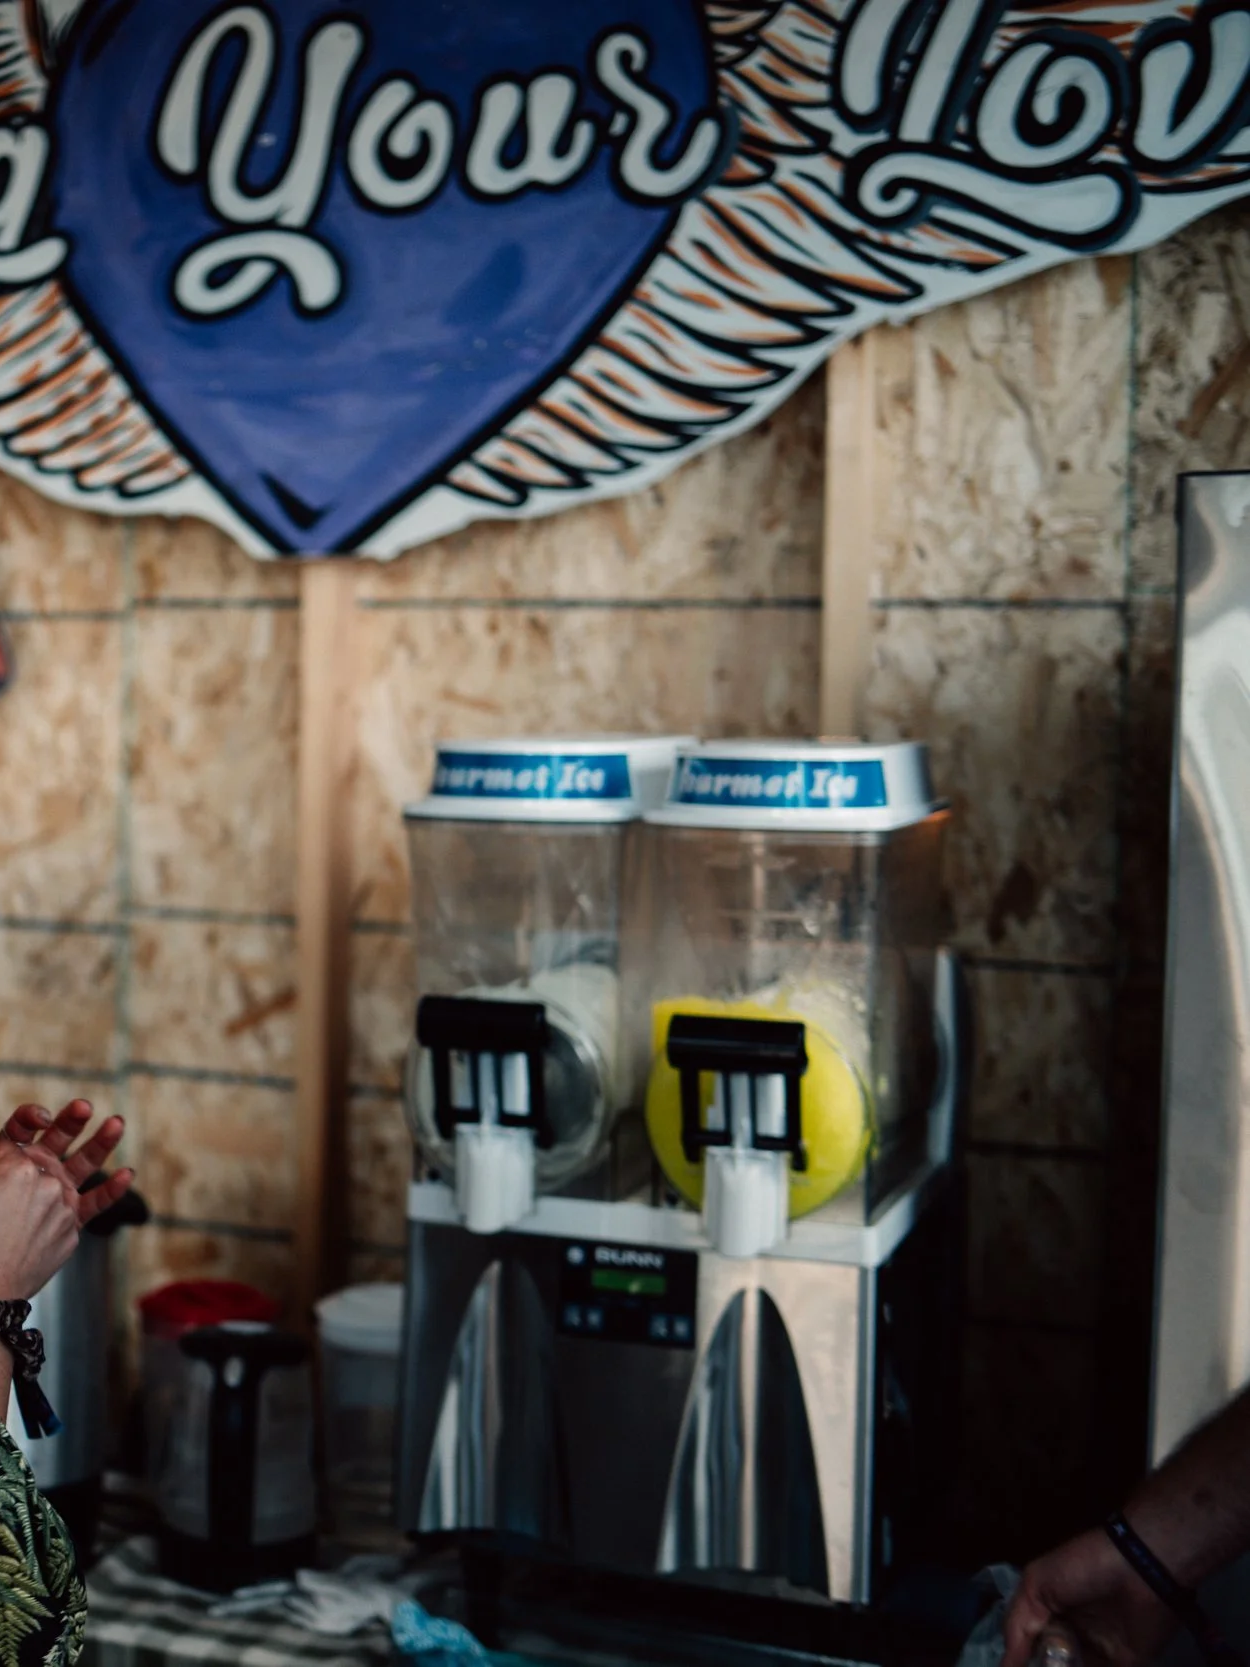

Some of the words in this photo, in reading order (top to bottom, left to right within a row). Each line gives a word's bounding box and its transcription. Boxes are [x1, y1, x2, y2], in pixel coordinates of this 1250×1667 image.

[154, 3, 724, 317] Your
[556, 761, 605, 793] Ice
[808, 768, 859, 800] Ice
[594, 1246, 665, 1270] BUNN
